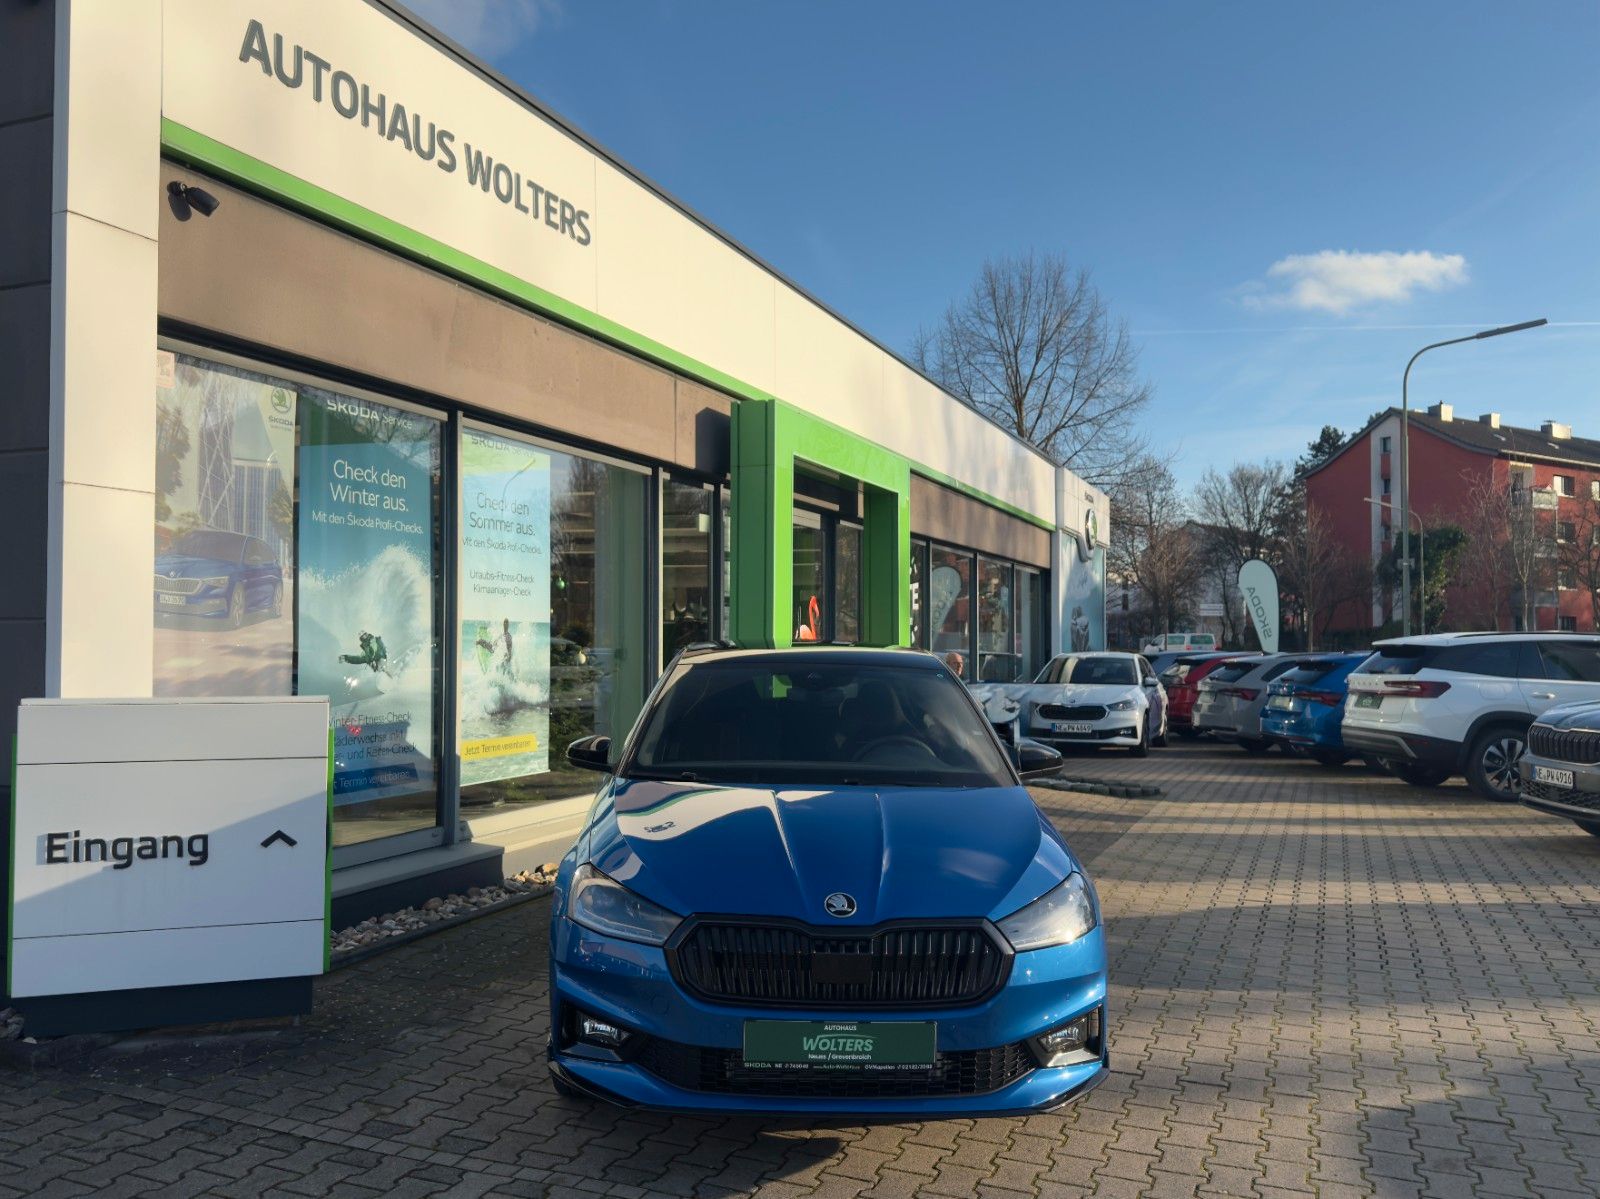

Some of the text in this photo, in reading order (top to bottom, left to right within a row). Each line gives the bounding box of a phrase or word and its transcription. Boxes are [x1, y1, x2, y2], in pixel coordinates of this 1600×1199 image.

[239, 19, 592, 247] AUTOHAUS WOLTERS
[333, 459, 406, 490] Check den
[330, 482, 409, 512] Winter aus.
[511, 497, 530, 515] den
[312, 510, 327, 522] Mit
[329, 513, 345, 525] den
[470, 512, 536, 536] Sommer aus.
[1556, 771, 1572, 785] 4916
[46, 829, 209, 870] Eingang
[803, 1035, 874, 1052] WOLTERS
